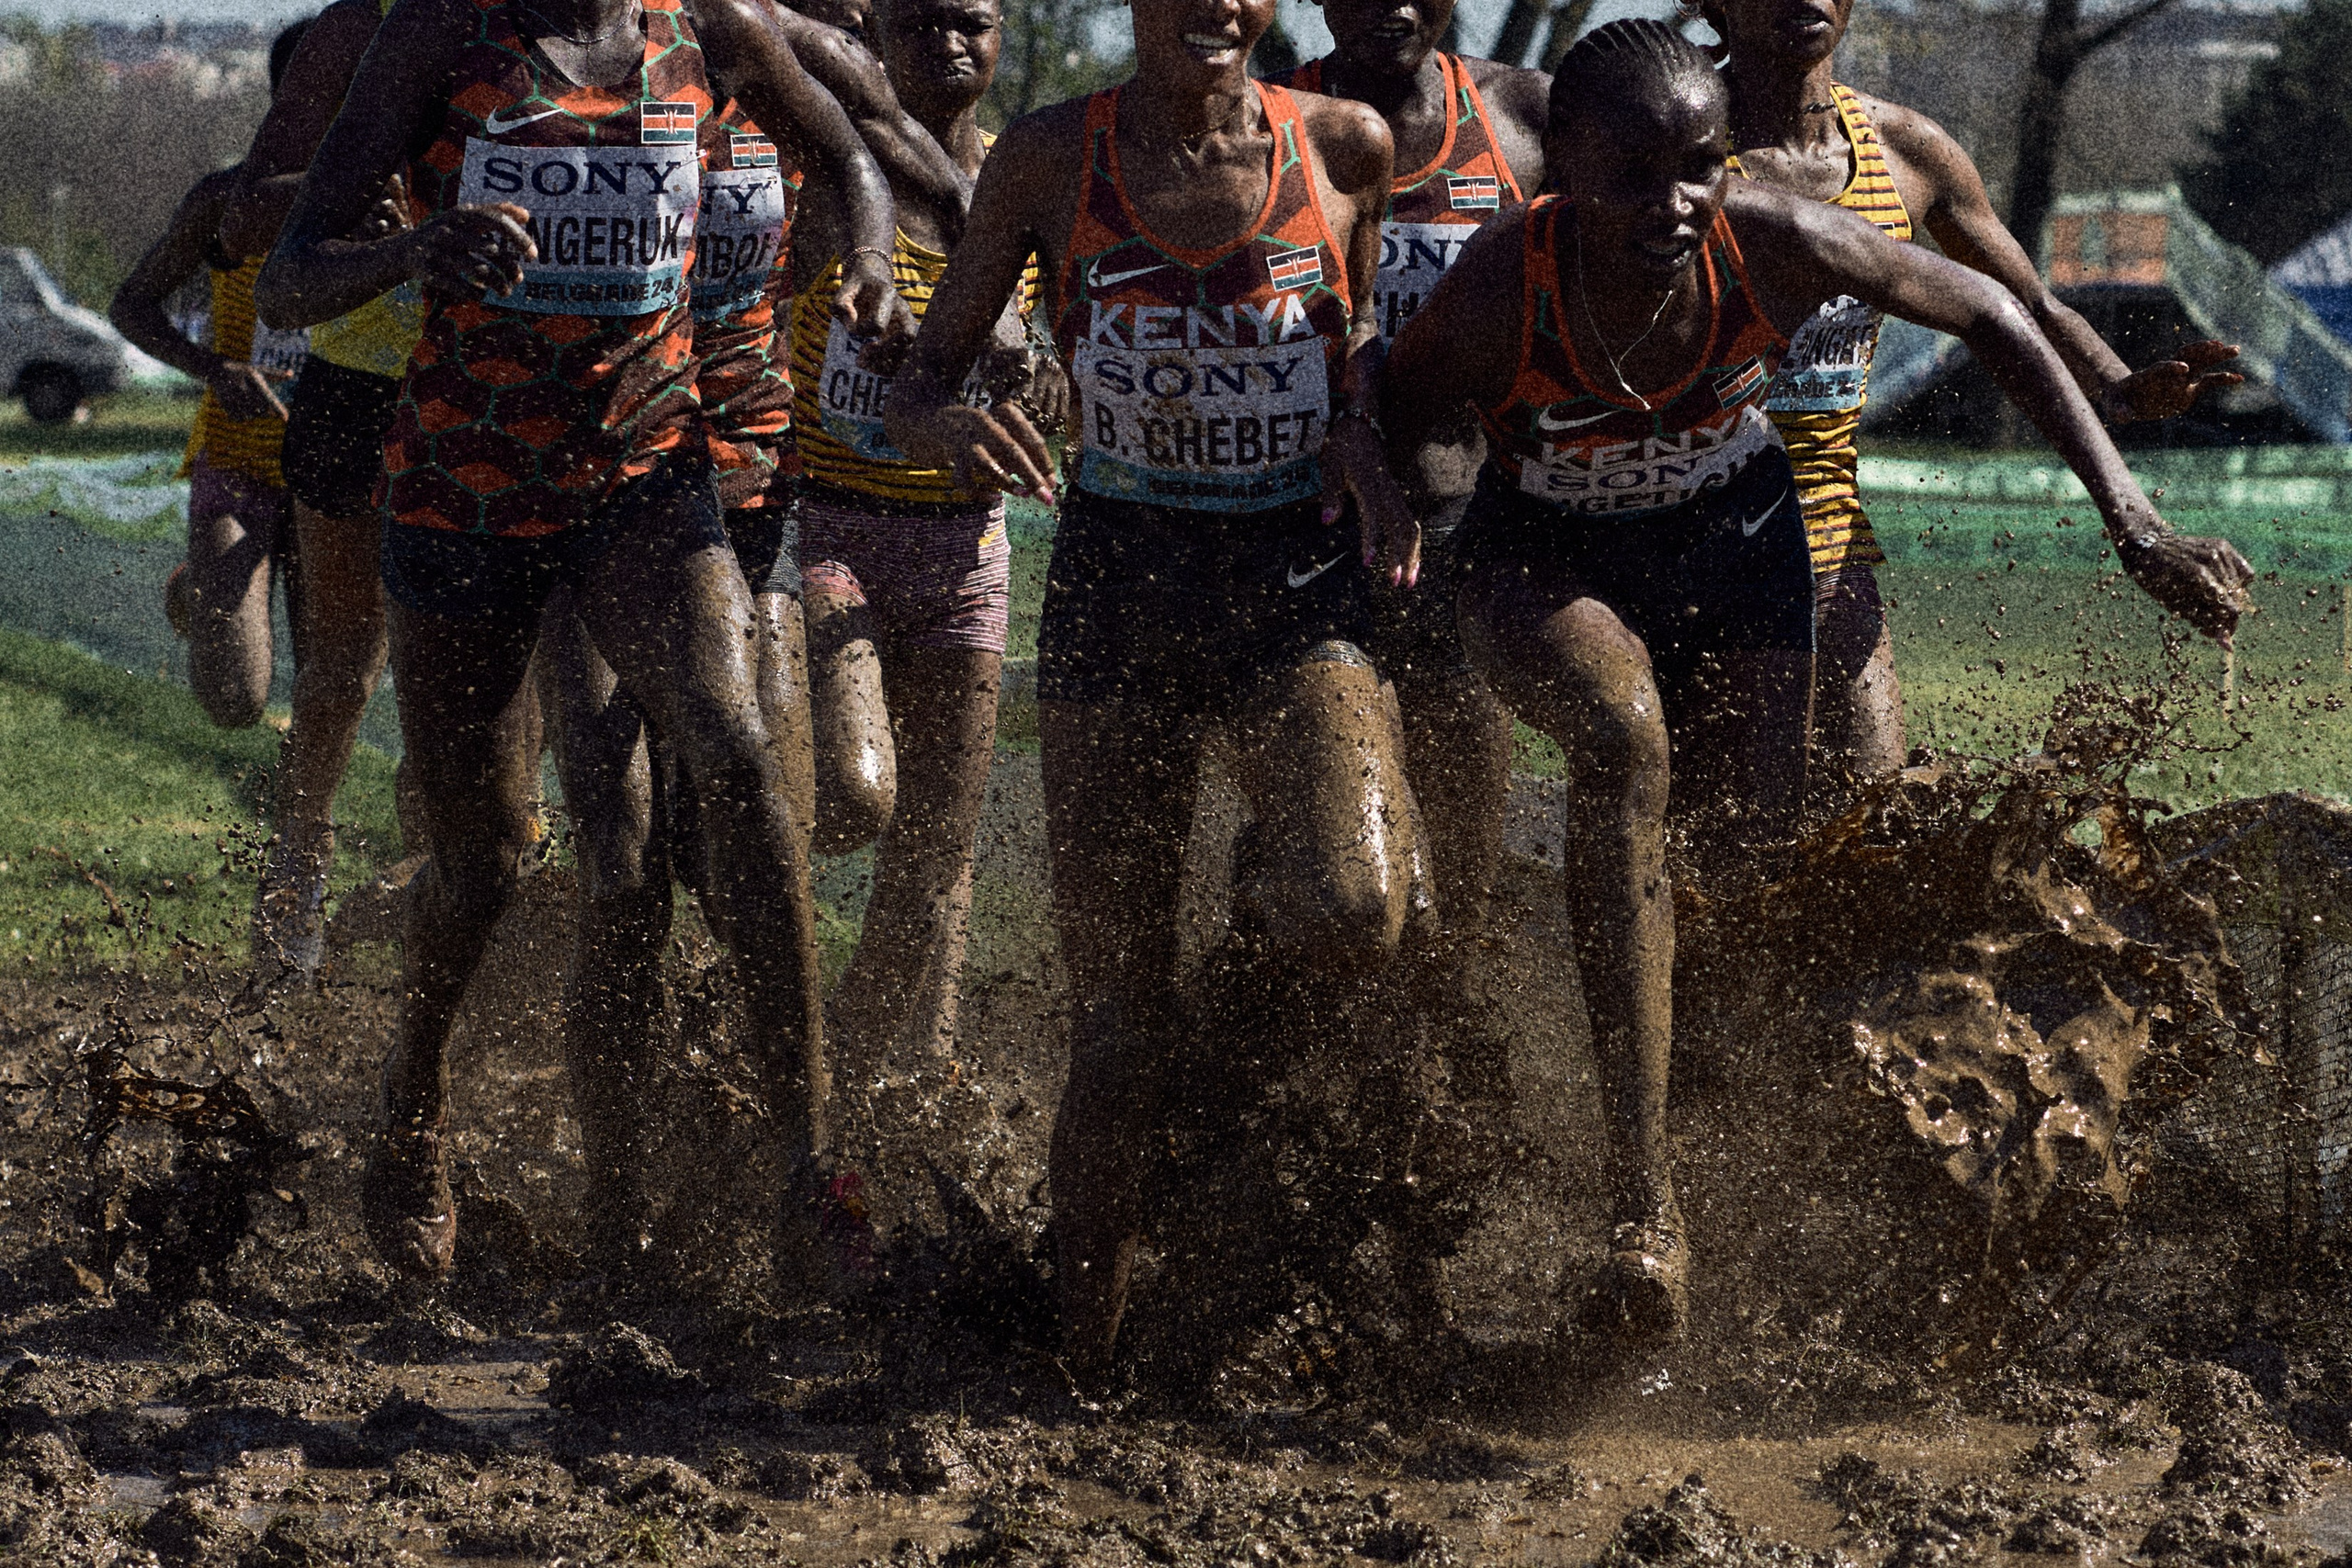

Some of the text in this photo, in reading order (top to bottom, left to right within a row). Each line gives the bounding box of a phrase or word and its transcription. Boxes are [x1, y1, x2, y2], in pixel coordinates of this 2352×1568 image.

[483, 157, 682, 197] SONY
[701, 178, 777, 215] NY
[1089, 293, 1316, 349] KENYA
[1094, 355, 1304, 400] SONY
[1094, 400, 1317, 467] B. CHEBET
[1547, 454, 1716, 491] SON
